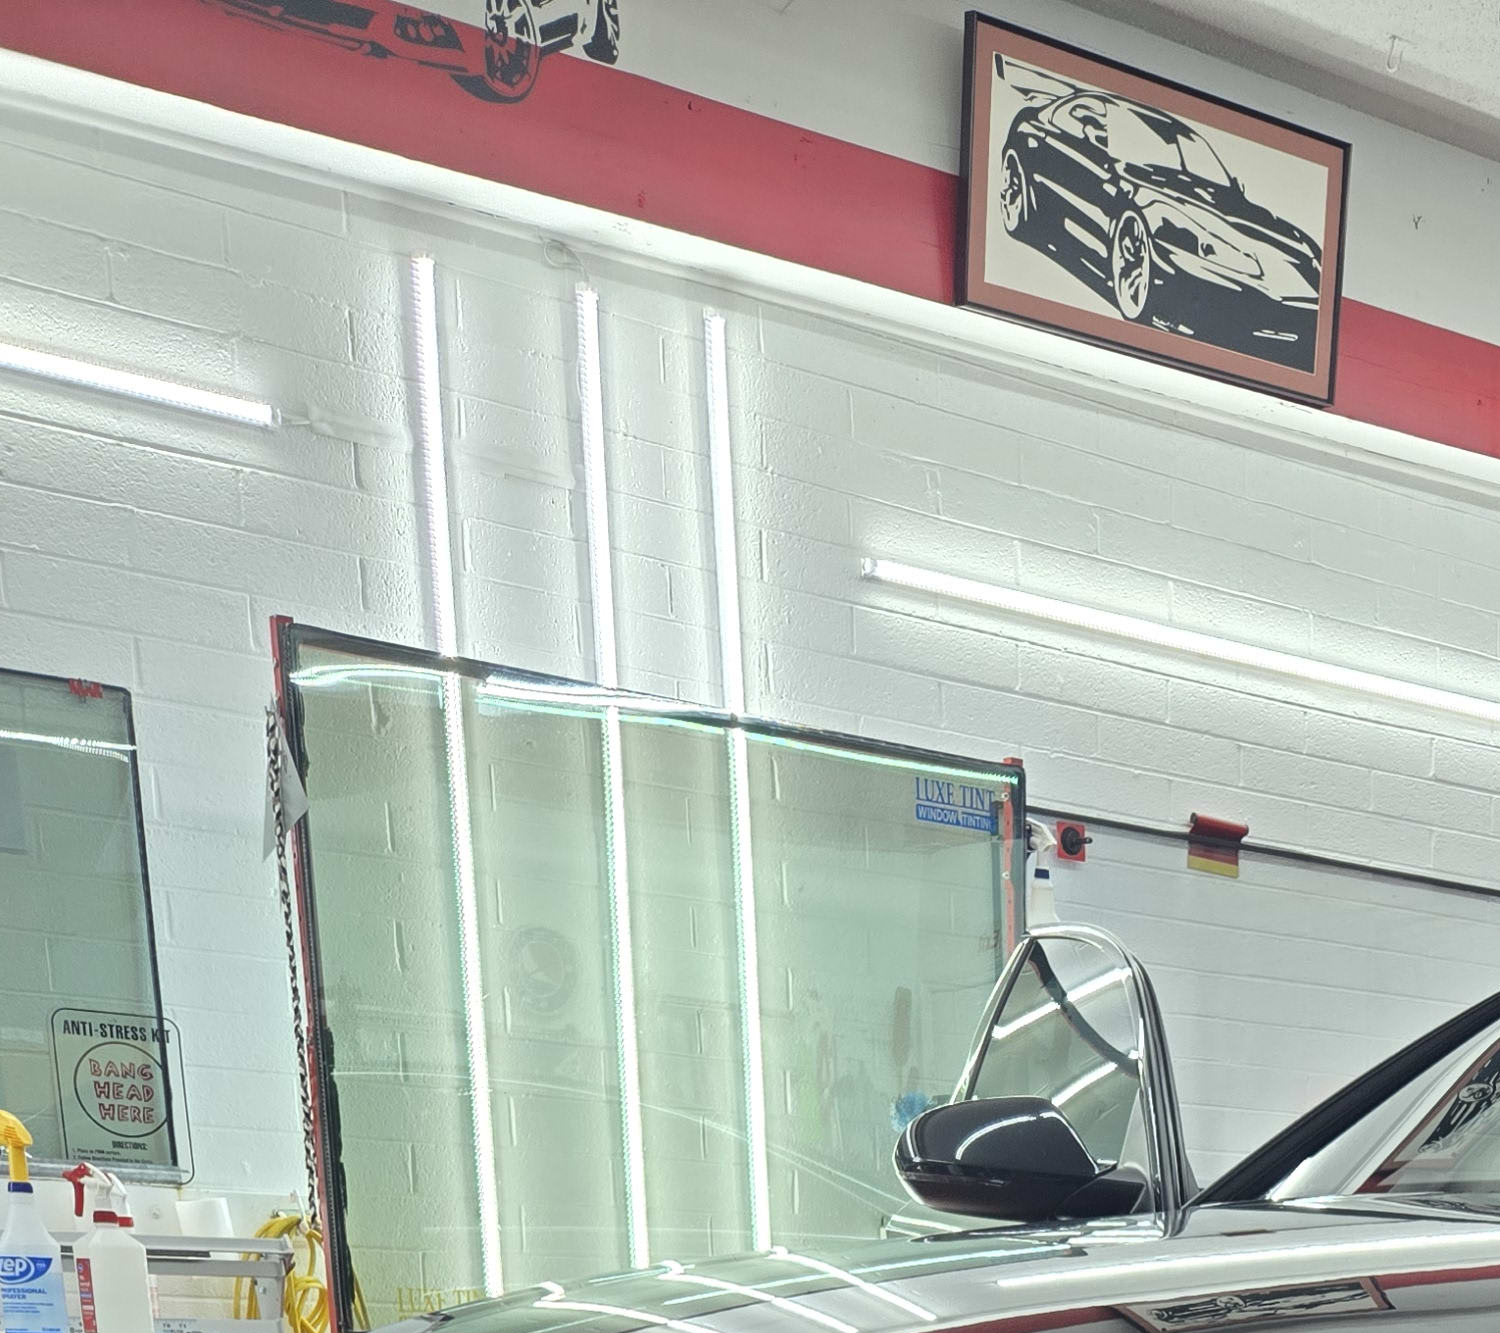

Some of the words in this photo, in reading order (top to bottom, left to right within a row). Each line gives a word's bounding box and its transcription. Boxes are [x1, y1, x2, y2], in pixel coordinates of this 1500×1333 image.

[915, 777, 954, 805] LUXE
[960, 785, 995, 812] TINT
[918, 806, 958, 824] WINDOW
[63, 1019, 147, 1042] ANTI-STRESS
[151, 1028, 171, 1044] KT
[88, 1058, 154, 1081] BANG
[93, 1081, 154, 1102] HEAD
[98, 1103, 155, 1124] HERE
[0, 1257, 28, 1277] ep
